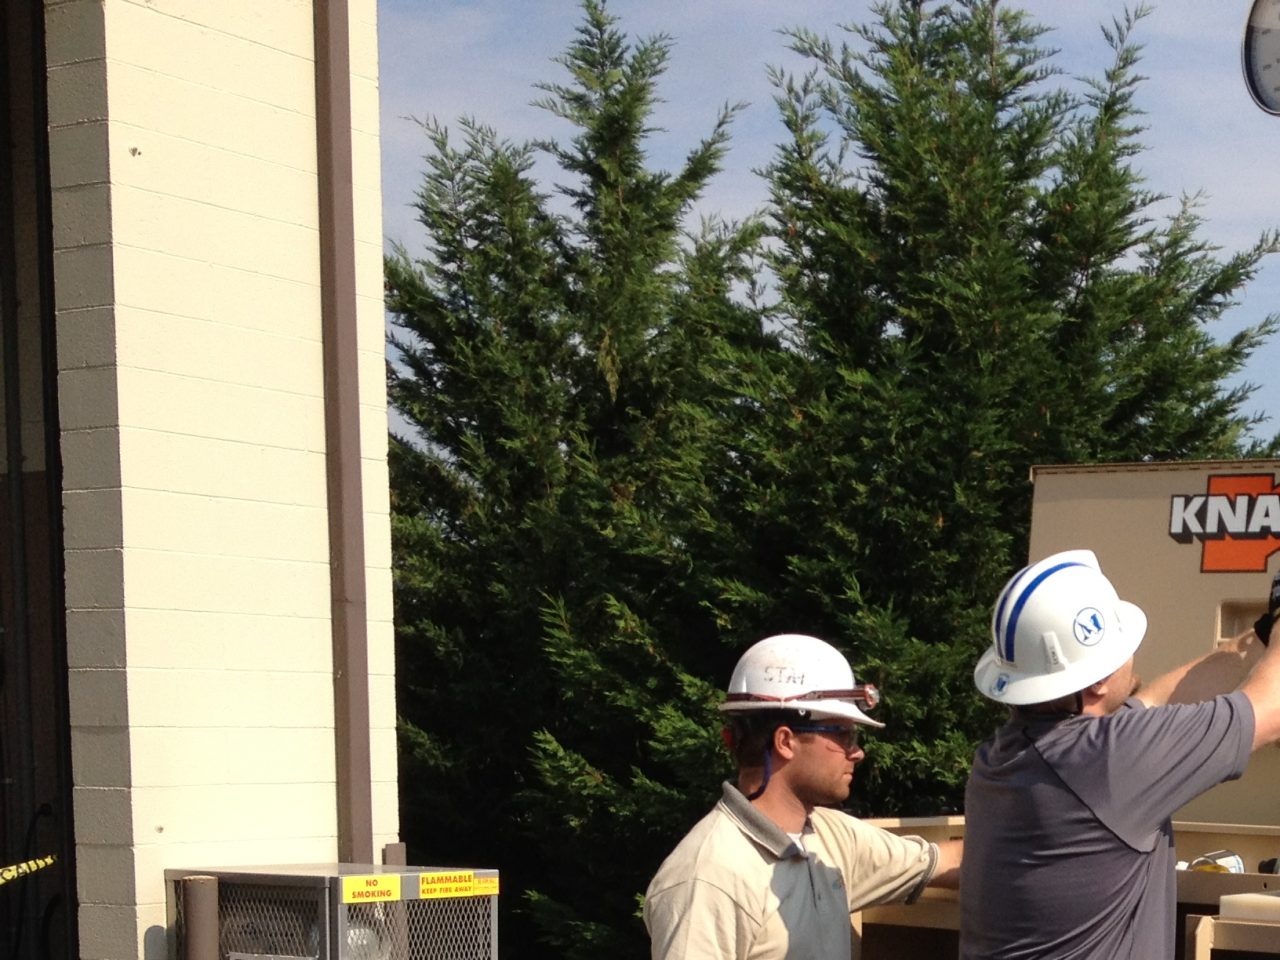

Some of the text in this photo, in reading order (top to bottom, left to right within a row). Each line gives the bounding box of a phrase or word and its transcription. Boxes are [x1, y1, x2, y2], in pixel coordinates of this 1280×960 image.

[365, 879, 379, 887] NO
[421, 874, 472, 885] FLAMMABLE
[352, 890, 392, 899] SMOKING
[421, 887, 437, 895] KEEP
